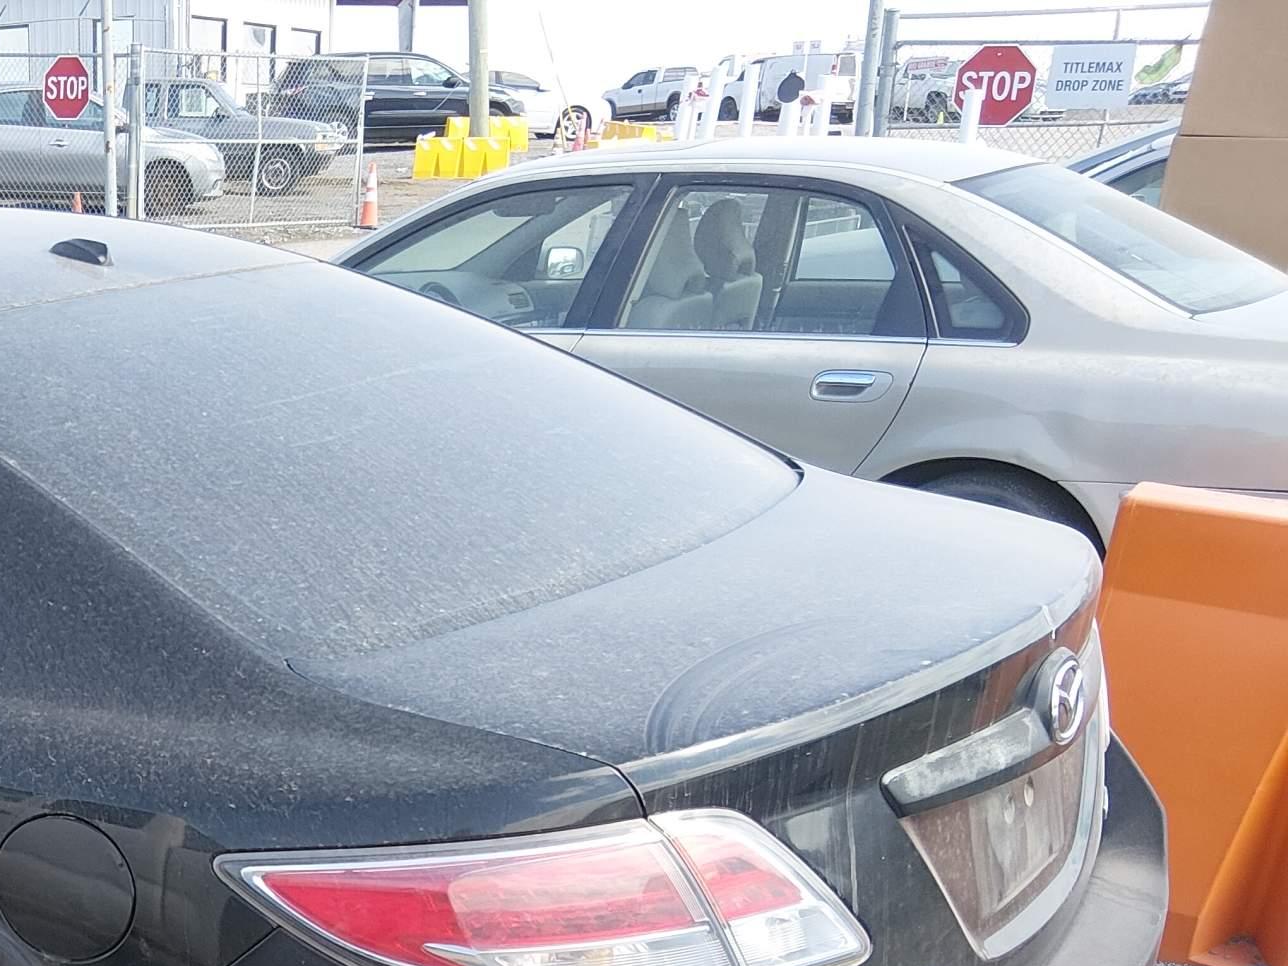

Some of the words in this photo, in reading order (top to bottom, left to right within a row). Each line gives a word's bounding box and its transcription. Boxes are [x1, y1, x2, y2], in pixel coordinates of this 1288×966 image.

[1063, 61, 1123, 73] TITLEMAX
[46, 76, 87, 100] STOP
[959, 71, 1031, 101] STOP
[1055, 79, 1089, 92] DROP
[1091, 79, 1124, 92] ZONE
